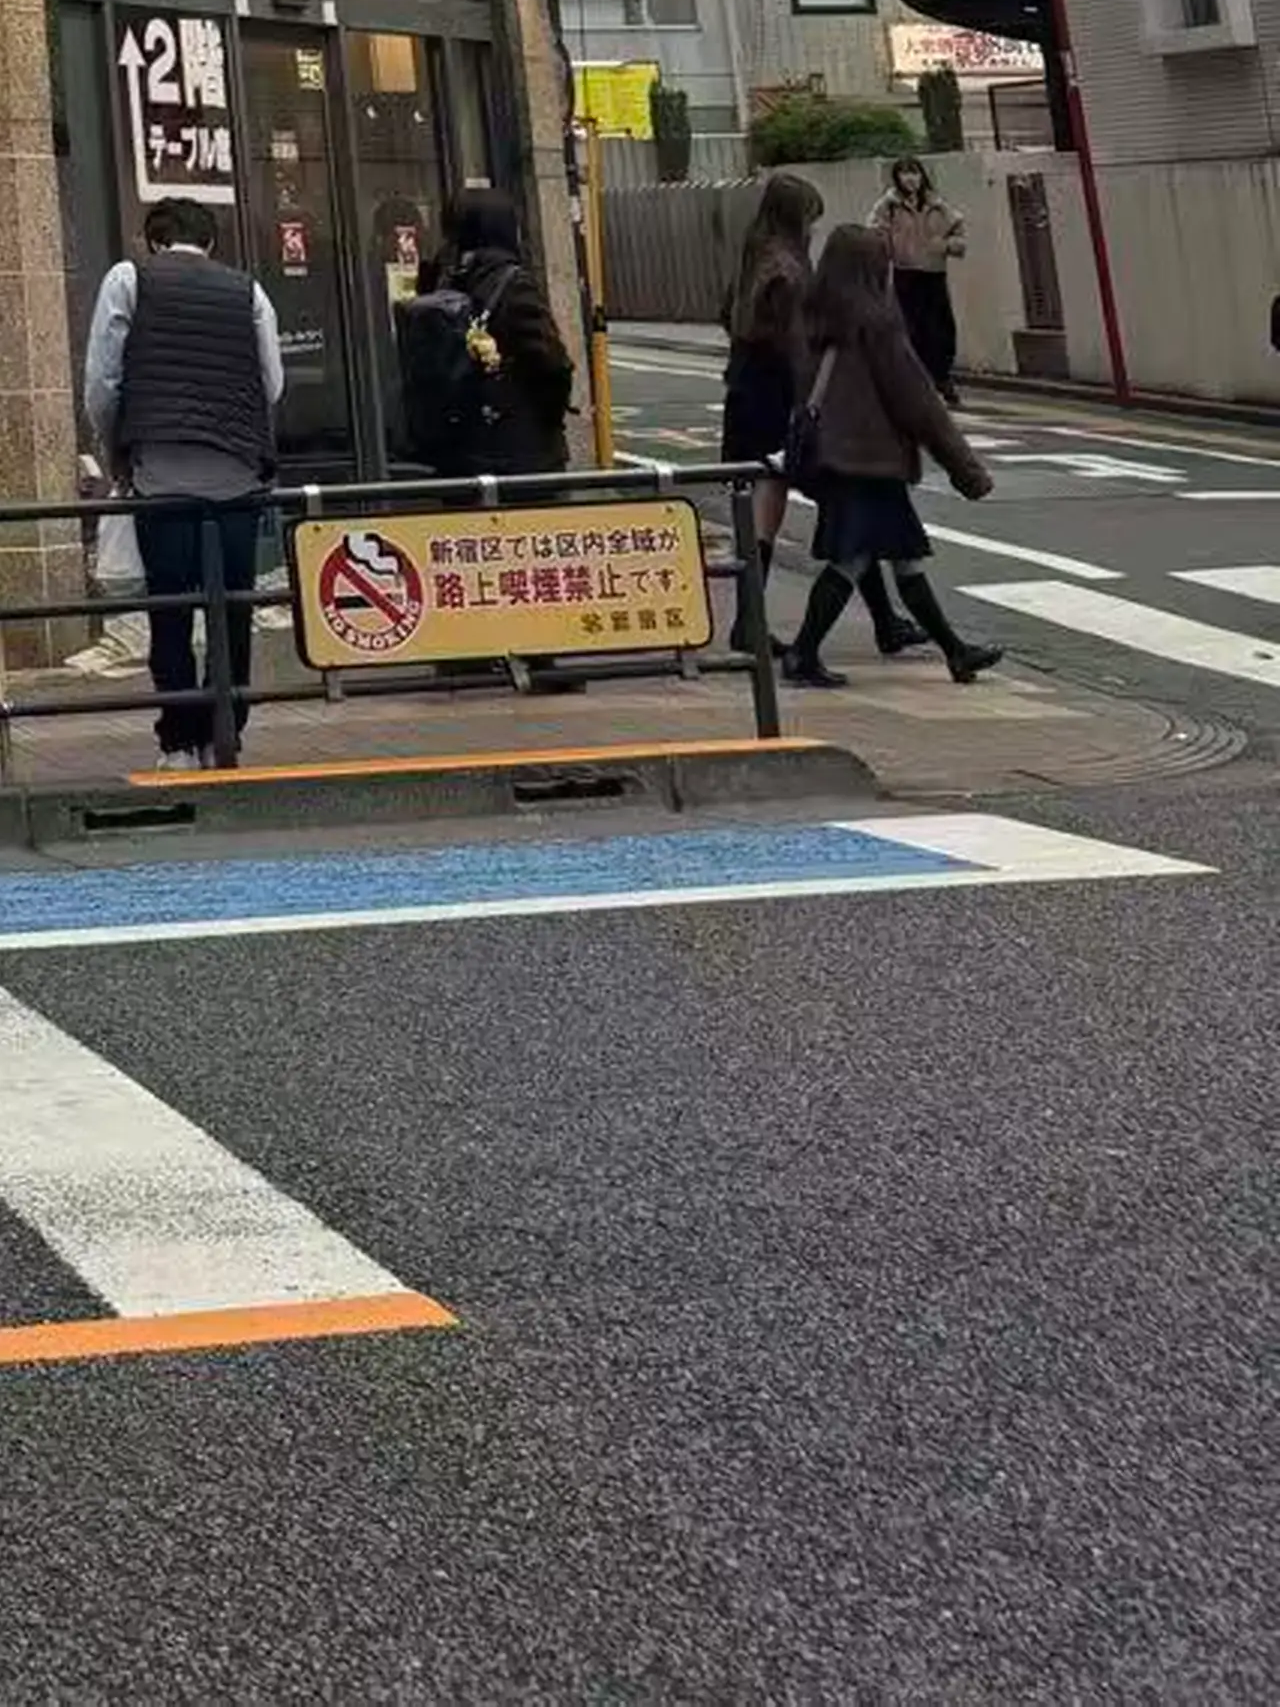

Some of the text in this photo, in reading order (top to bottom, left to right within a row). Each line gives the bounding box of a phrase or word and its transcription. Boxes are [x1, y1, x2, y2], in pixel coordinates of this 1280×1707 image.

[144, 17, 228, 108] 2階
[429, 527, 681, 565] 新宿区では区内全域が
